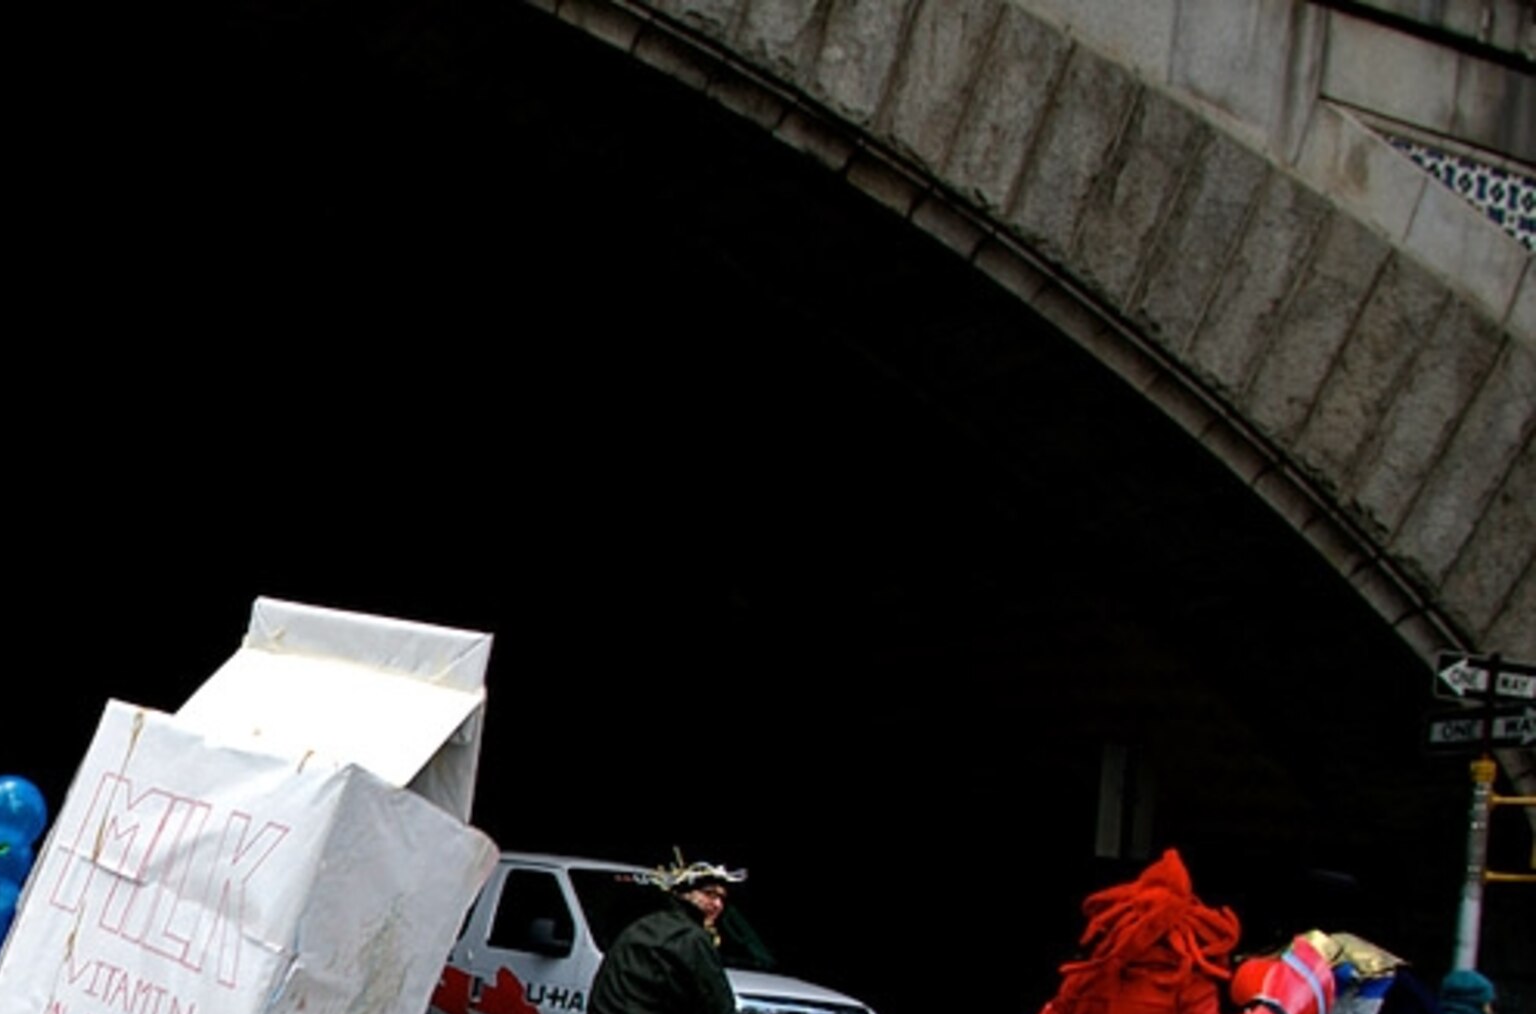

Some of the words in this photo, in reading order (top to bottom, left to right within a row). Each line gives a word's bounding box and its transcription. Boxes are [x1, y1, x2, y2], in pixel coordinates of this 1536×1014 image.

[1449, 667, 1481, 688] ONE
[1500, 675, 1531, 692] WAY
[1440, 719, 1477, 741] ONE
[1503, 717, 1536, 738] WA
[50, 771, 290, 988] MILK
